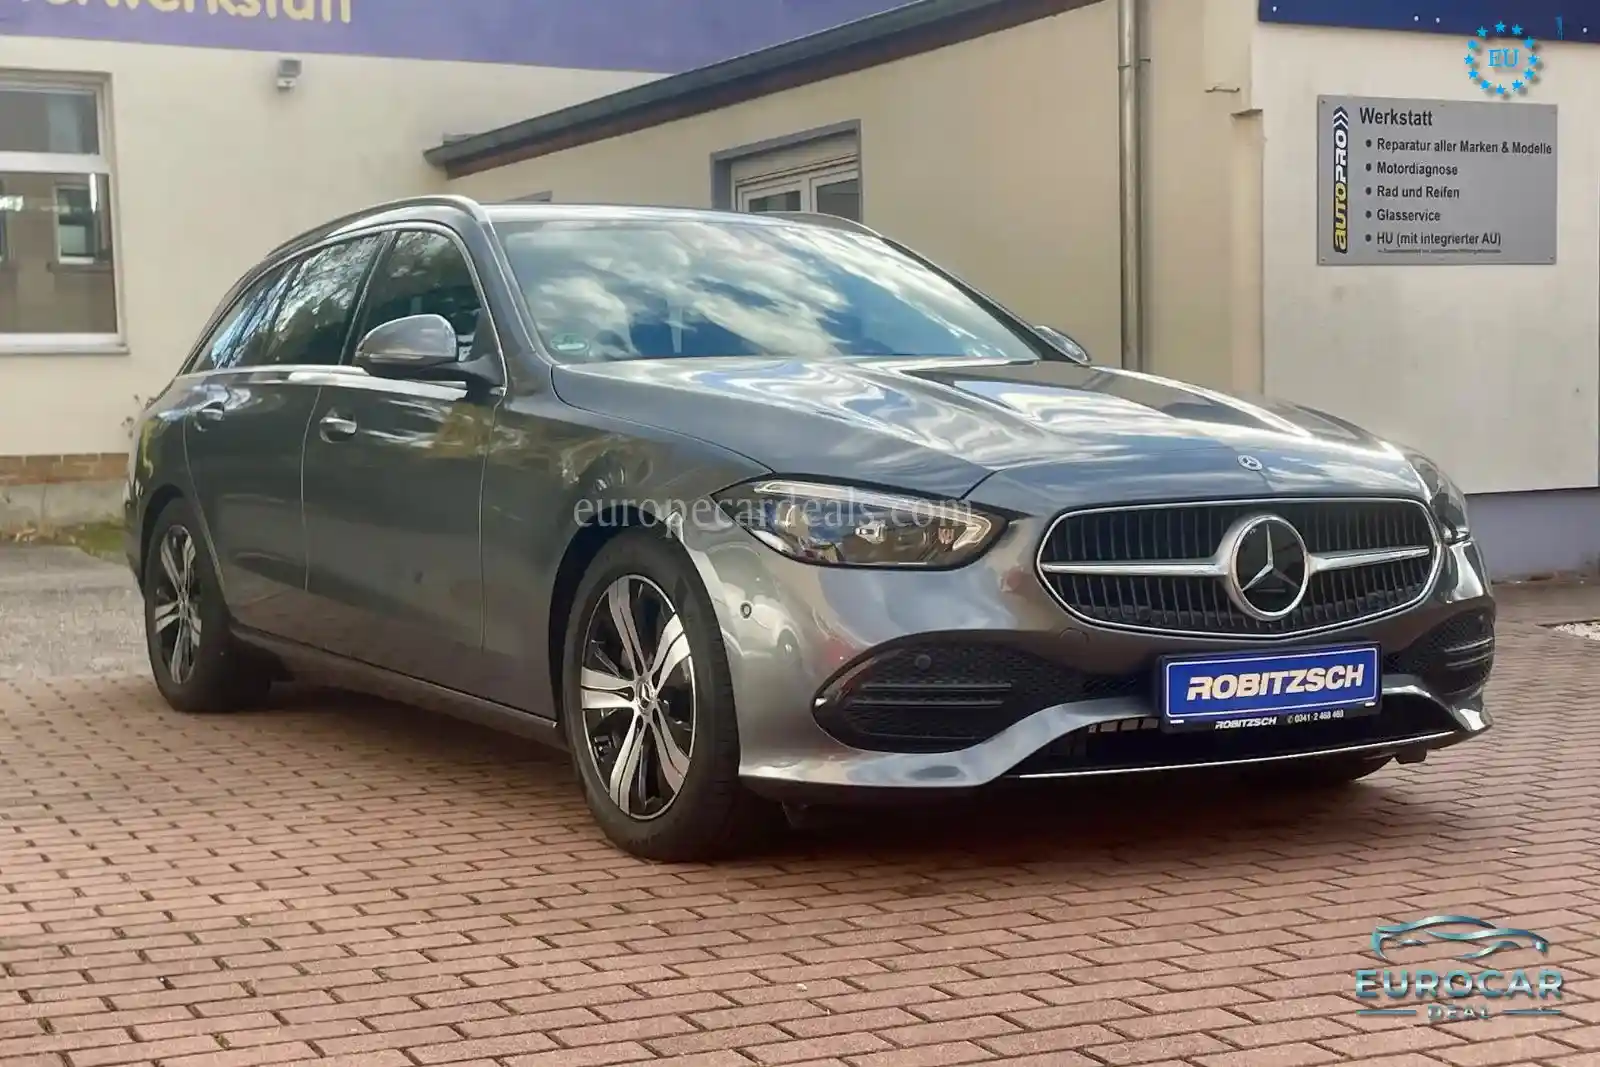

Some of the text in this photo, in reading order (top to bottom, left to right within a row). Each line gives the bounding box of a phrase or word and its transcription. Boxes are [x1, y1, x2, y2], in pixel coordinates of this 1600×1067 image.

[1359, 107, 1433, 127] Werkstatt
[1377, 138, 1552, 154] Reparatur aller Marken & Modelle
[1377, 161, 1458, 177] Motordiagnose
[1377, 185, 1460, 199] Rad und Reifen
[1377, 208, 1441, 222] Glasservice
[1377, 232, 1501, 248] HU (mit integrierter AU)
[1186, 663, 1365, 701] ROBITZSCH
[1215, 716, 1277, 730] ROBITZSCH
